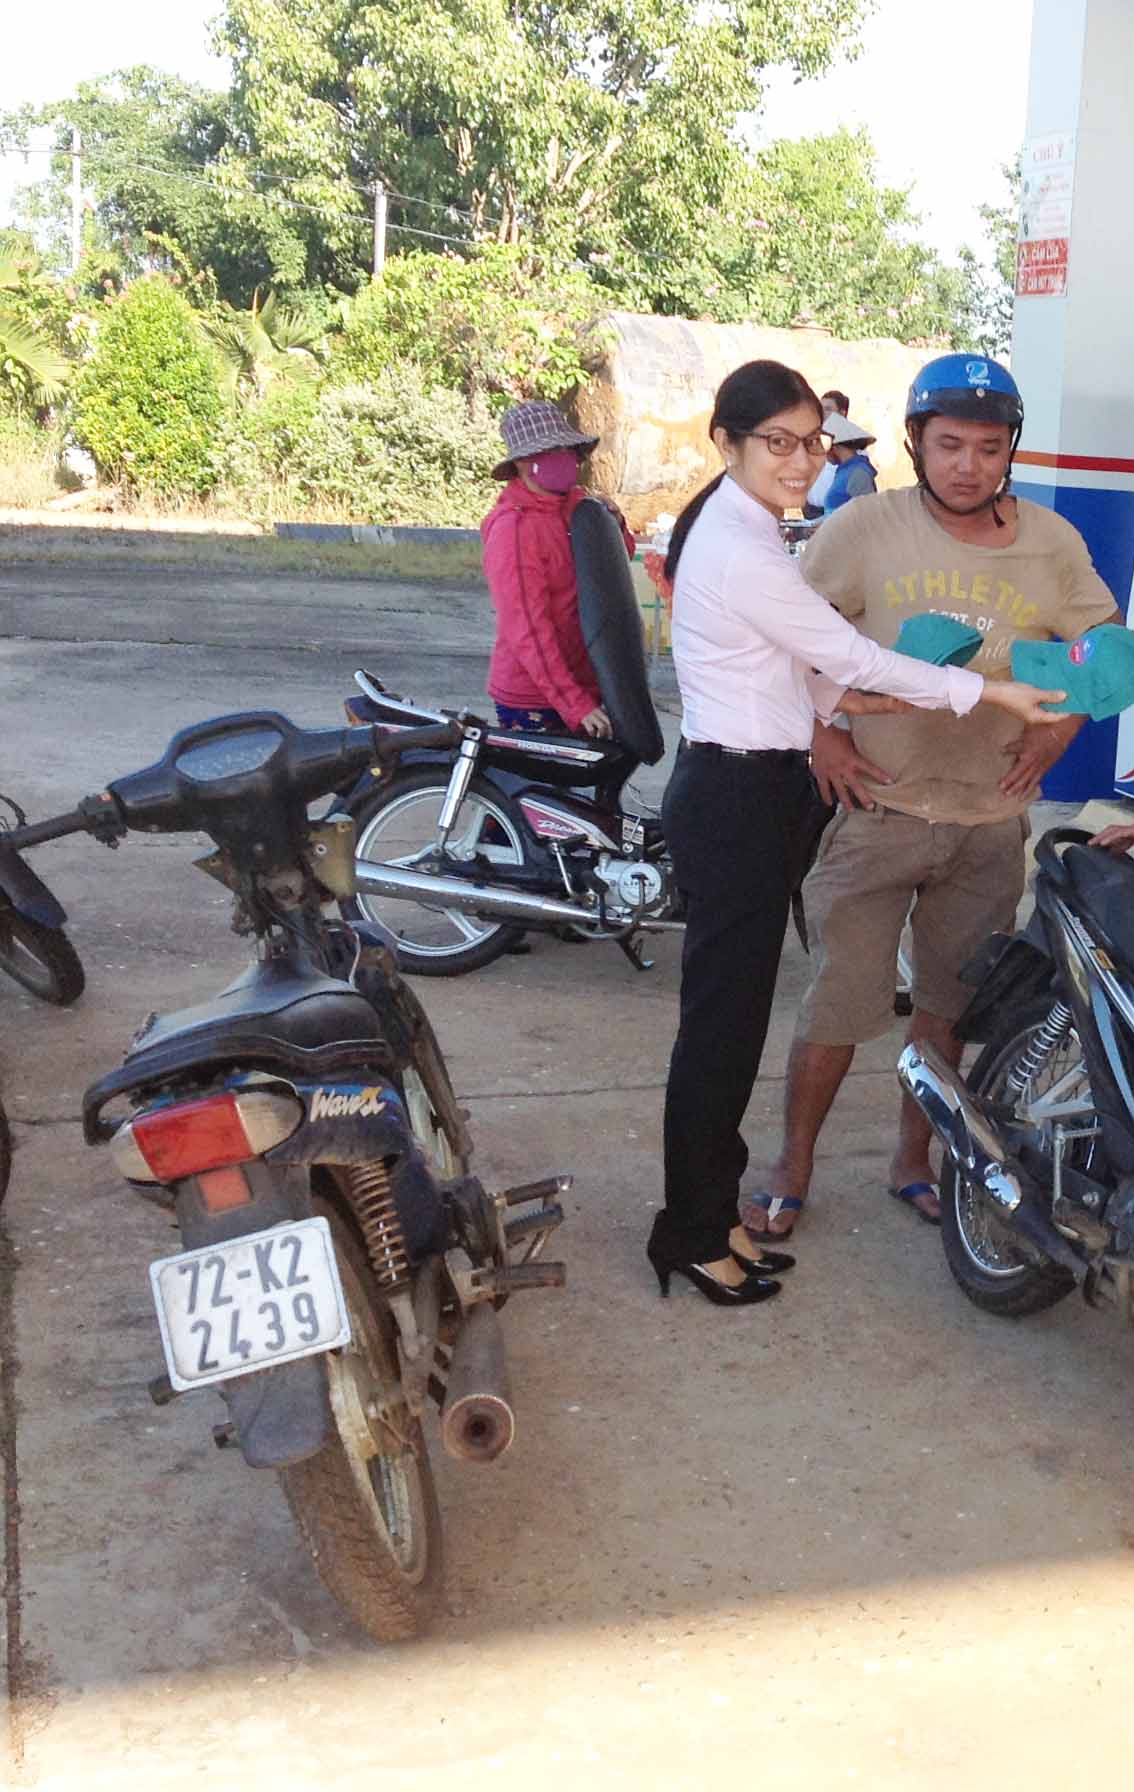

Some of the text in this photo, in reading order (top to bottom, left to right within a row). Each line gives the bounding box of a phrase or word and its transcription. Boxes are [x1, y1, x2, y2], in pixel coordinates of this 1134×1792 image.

[884, 569, 1040, 627] ATHLETIC
[976, 616, 997, 632] OF
[178, 1235, 309, 1316] 72-K2
[190, 1292, 320, 1372] 2439
